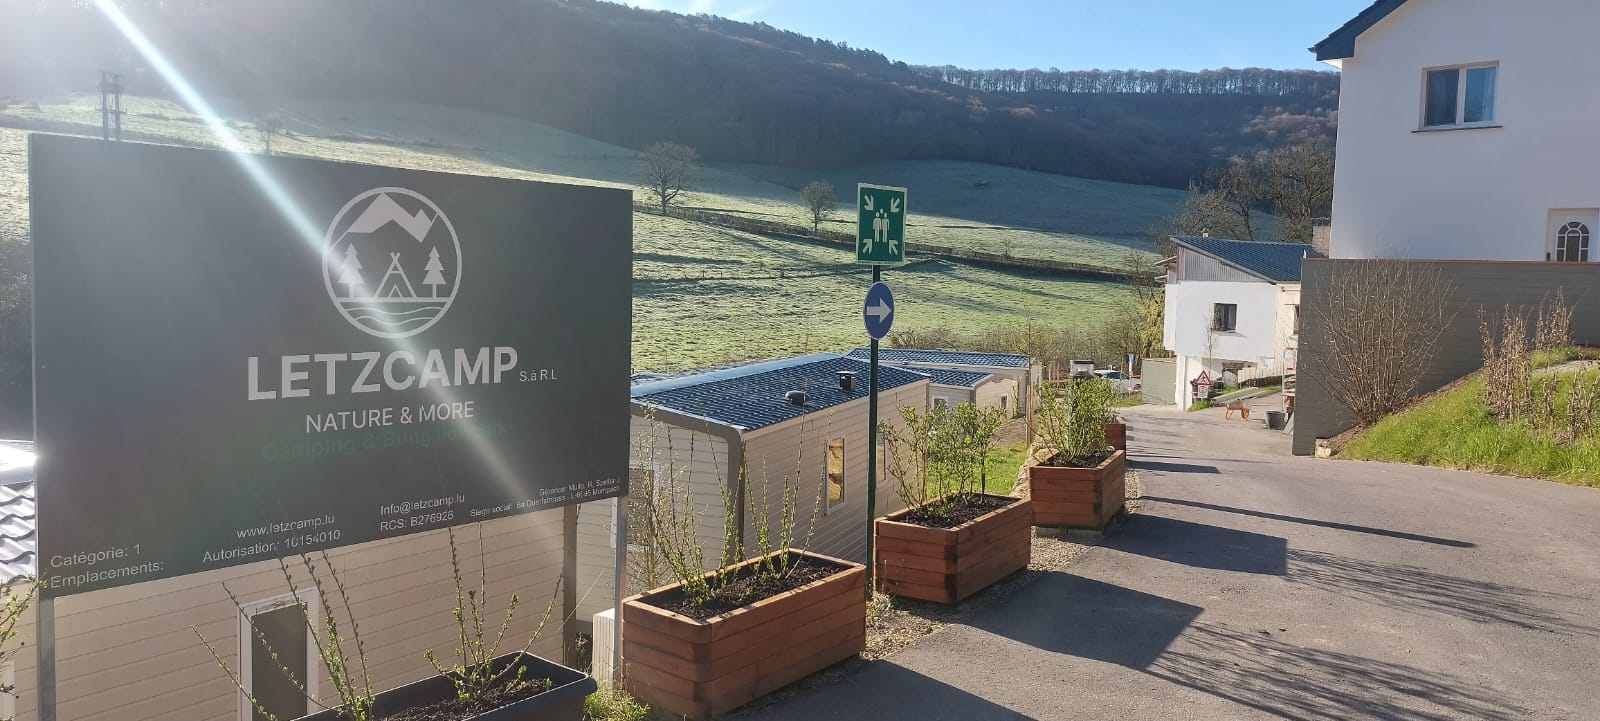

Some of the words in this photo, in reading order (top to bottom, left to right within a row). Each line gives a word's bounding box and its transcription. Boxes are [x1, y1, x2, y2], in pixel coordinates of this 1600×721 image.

[248, 346, 518, 401] LETZCAMP
[306, 407, 393, 433] NATURE
[400, 405, 413, 424] &
[419, 401, 474, 422] MORE
[380, 493, 465, 516] Info@letzcamp.lu
[236, 514, 336, 539] www.letzcamp.lu
[380, 518, 408, 534] RCS:
[284, 529, 341, 549] 10154010
[50, 546, 129, 568] Catégorie:
[134, 543, 141, 555] 1
[50, 560, 164, 589] Emplacements:
